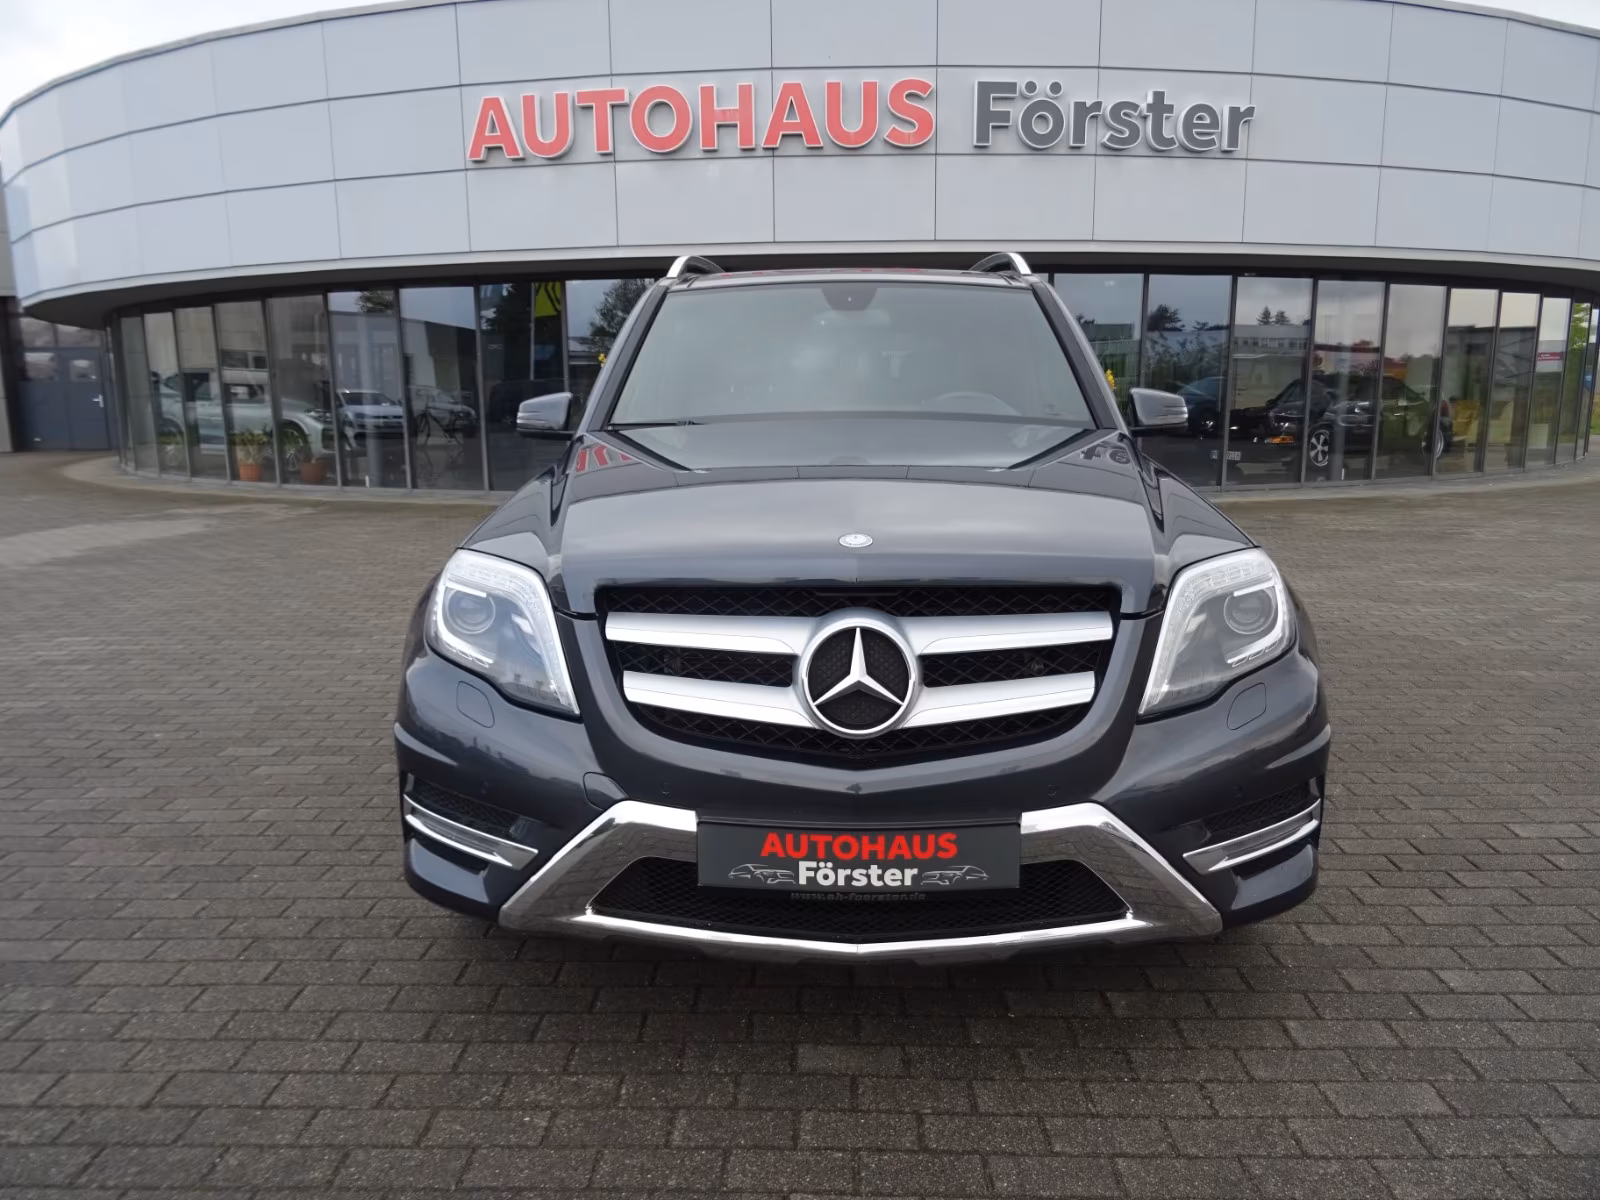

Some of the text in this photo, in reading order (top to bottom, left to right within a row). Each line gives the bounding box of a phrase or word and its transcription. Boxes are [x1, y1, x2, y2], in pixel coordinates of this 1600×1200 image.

[468, 79, 1256, 163] AUTOHAUS Förster
[760, 832, 958, 860] AUTOHAUS
[797, 861, 918, 887] Förster
